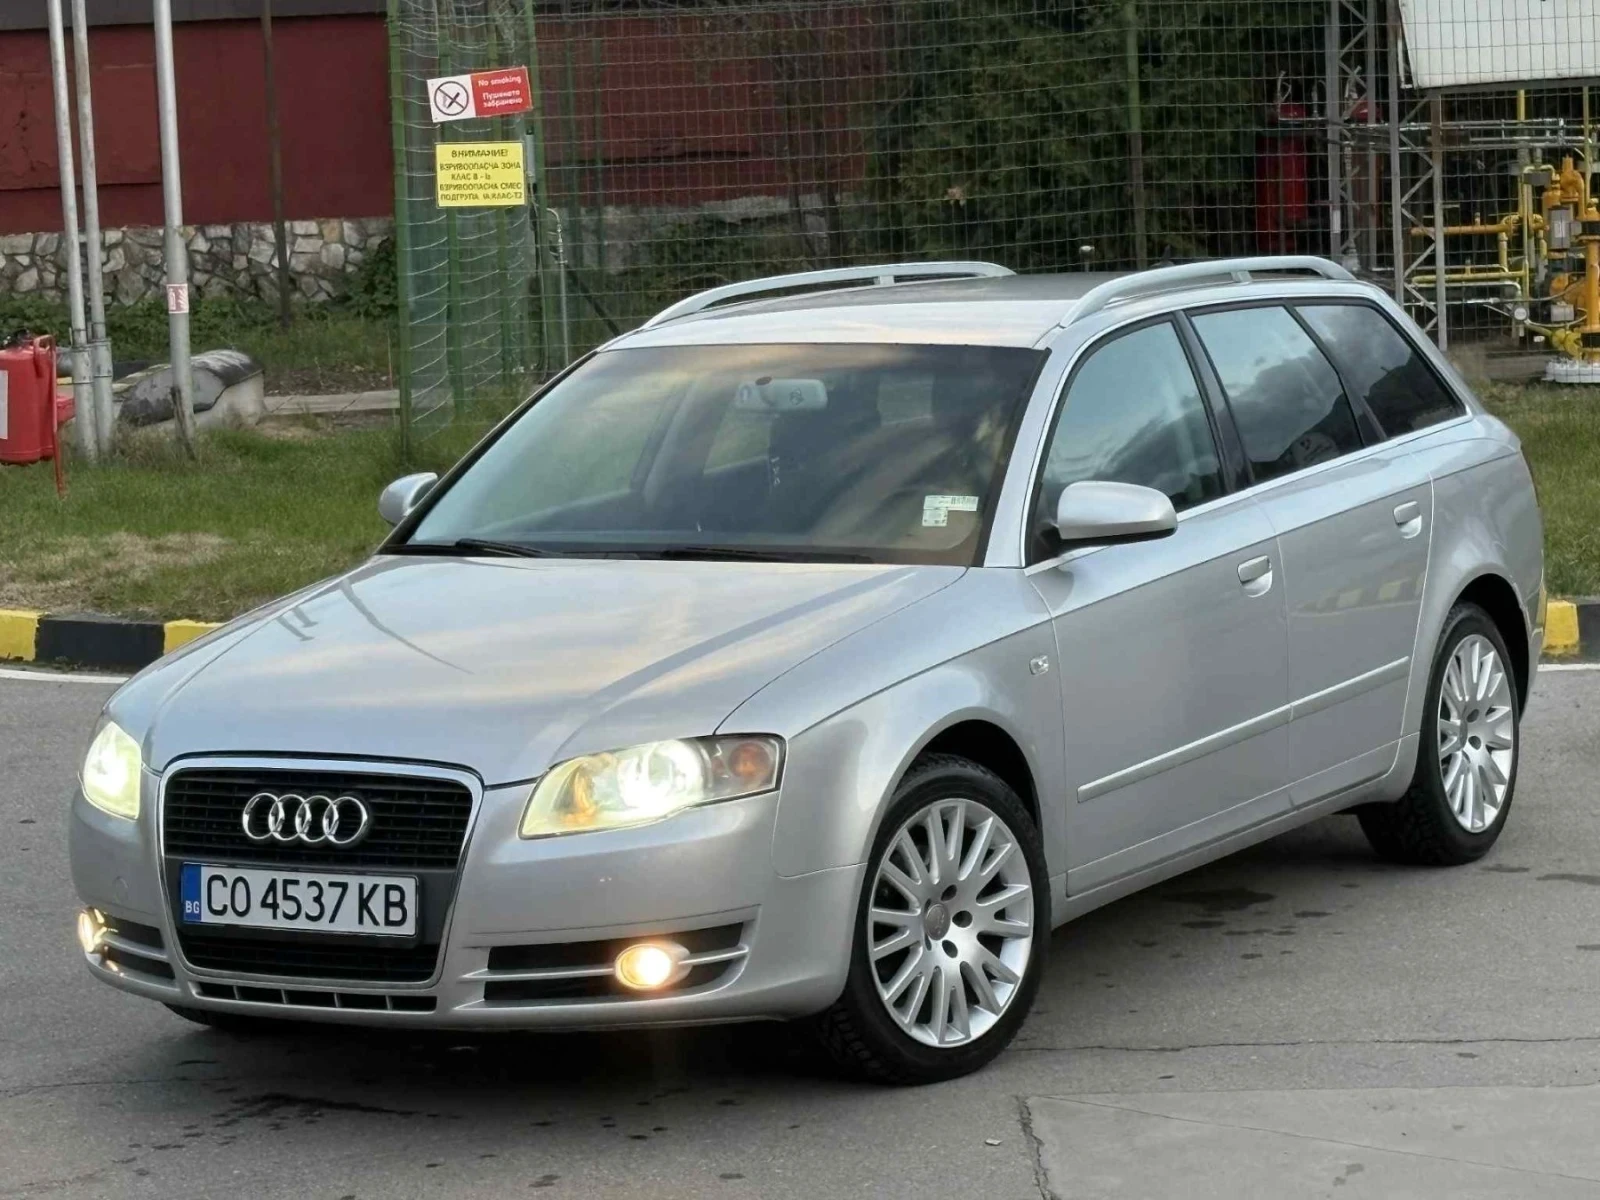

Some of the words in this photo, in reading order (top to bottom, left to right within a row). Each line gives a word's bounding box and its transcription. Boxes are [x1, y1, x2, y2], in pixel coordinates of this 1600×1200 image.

[490, 76, 521, 85] smoking
[482, 90, 520, 100] Пушенето
[483, 98, 523, 108] забранено
[501, 161, 521, 170] ЗОНА
[500, 182, 522, 190] СМЕС
[440, 193, 479, 201] ПОДГРУПА
[206, 874, 251, 918] CO
[260, 878, 349, 924] 4537
[357, 882, 408, 927] KB
[185, 901, 200, 914] BG
